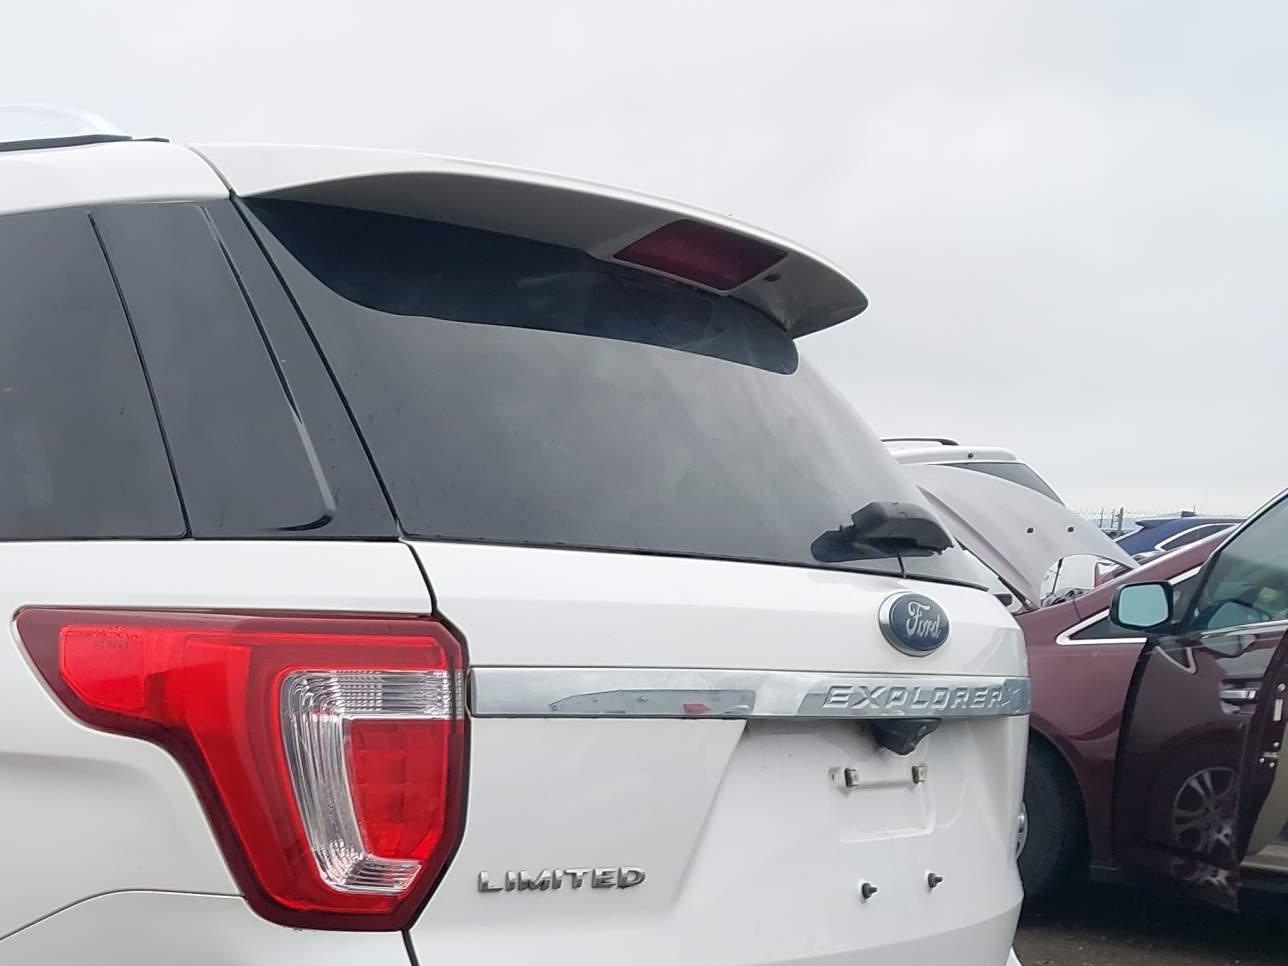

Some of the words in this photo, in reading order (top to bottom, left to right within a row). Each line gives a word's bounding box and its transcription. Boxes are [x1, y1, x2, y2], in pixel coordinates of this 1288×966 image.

[906, 601, 941, 638] Ford
[822, 685, 1010, 710] EXPLORER
[478, 867, 646, 893] LIMITED
